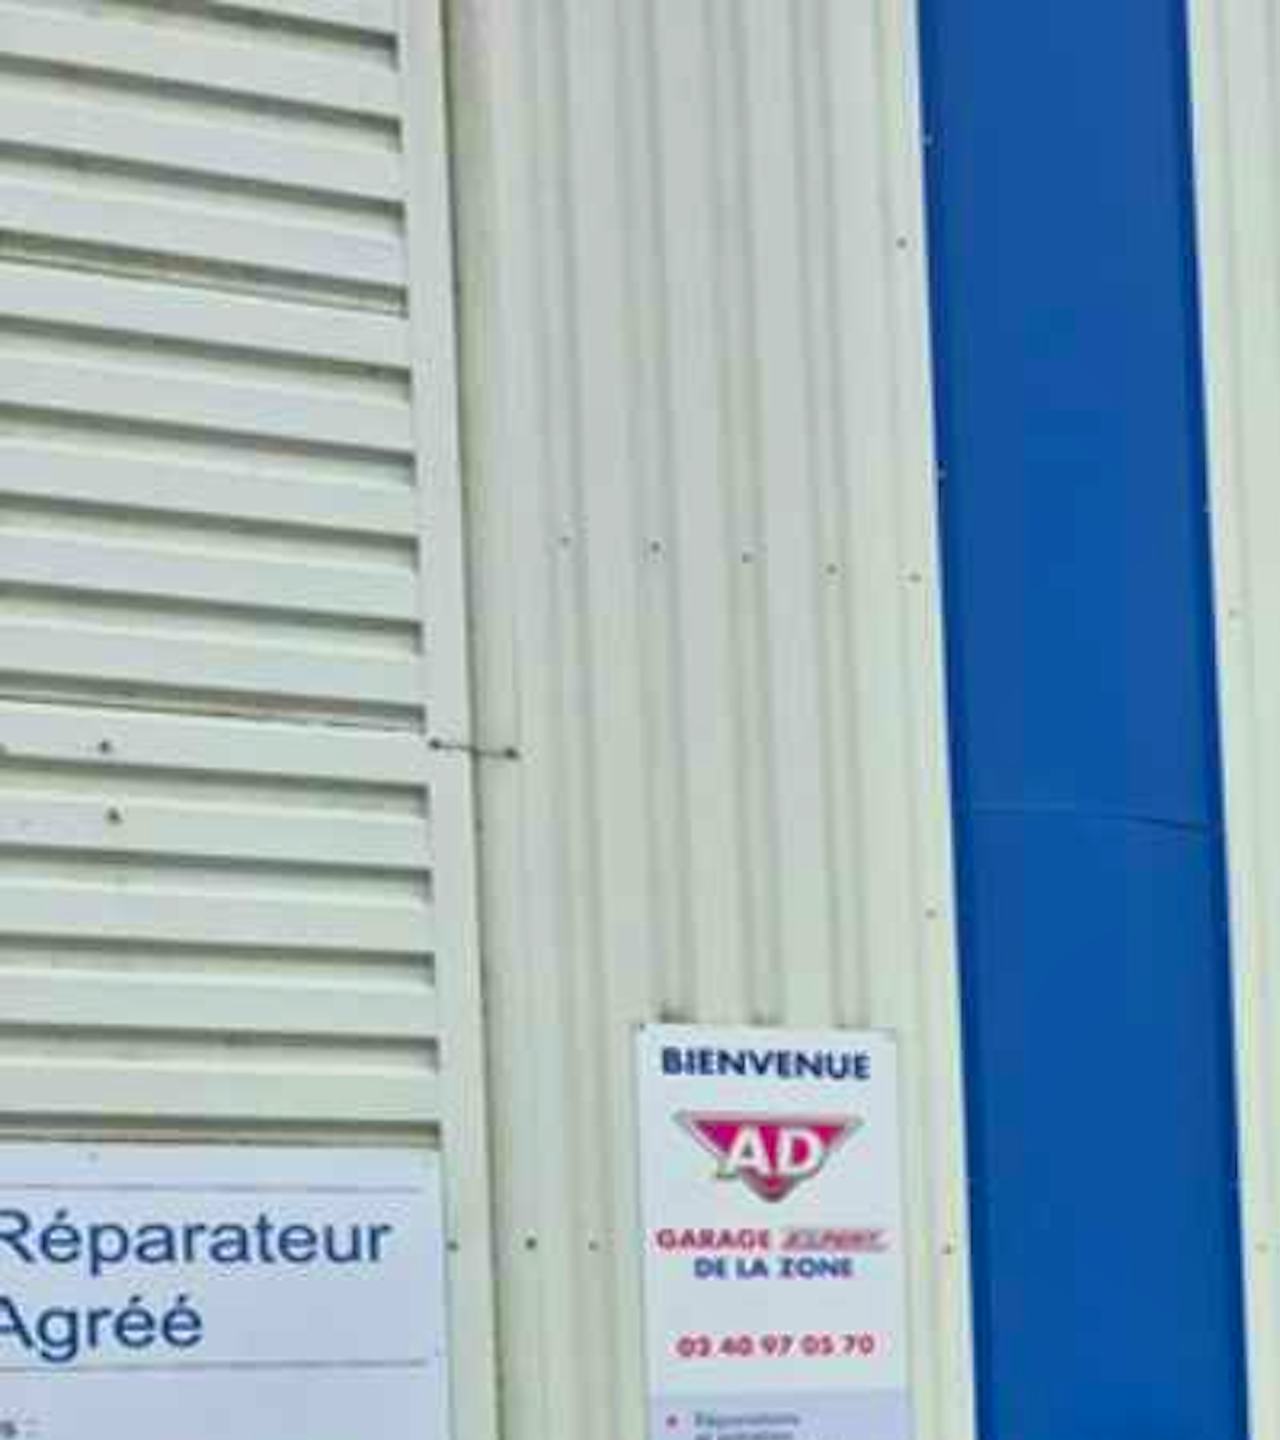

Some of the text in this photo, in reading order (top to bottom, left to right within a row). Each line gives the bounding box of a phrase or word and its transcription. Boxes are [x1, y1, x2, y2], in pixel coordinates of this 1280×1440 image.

[660, 1046, 871, 1080] BIENVENUE
[724, 1123, 826, 1177] AD
[0, 1207, 391, 1276] Réparateur
[656, 1228, 769, 1250] GARAGE
[694, 1257, 854, 1279] DE LA ZONE
[675, 1332, 876, 1357] 02 40 97 05 70
